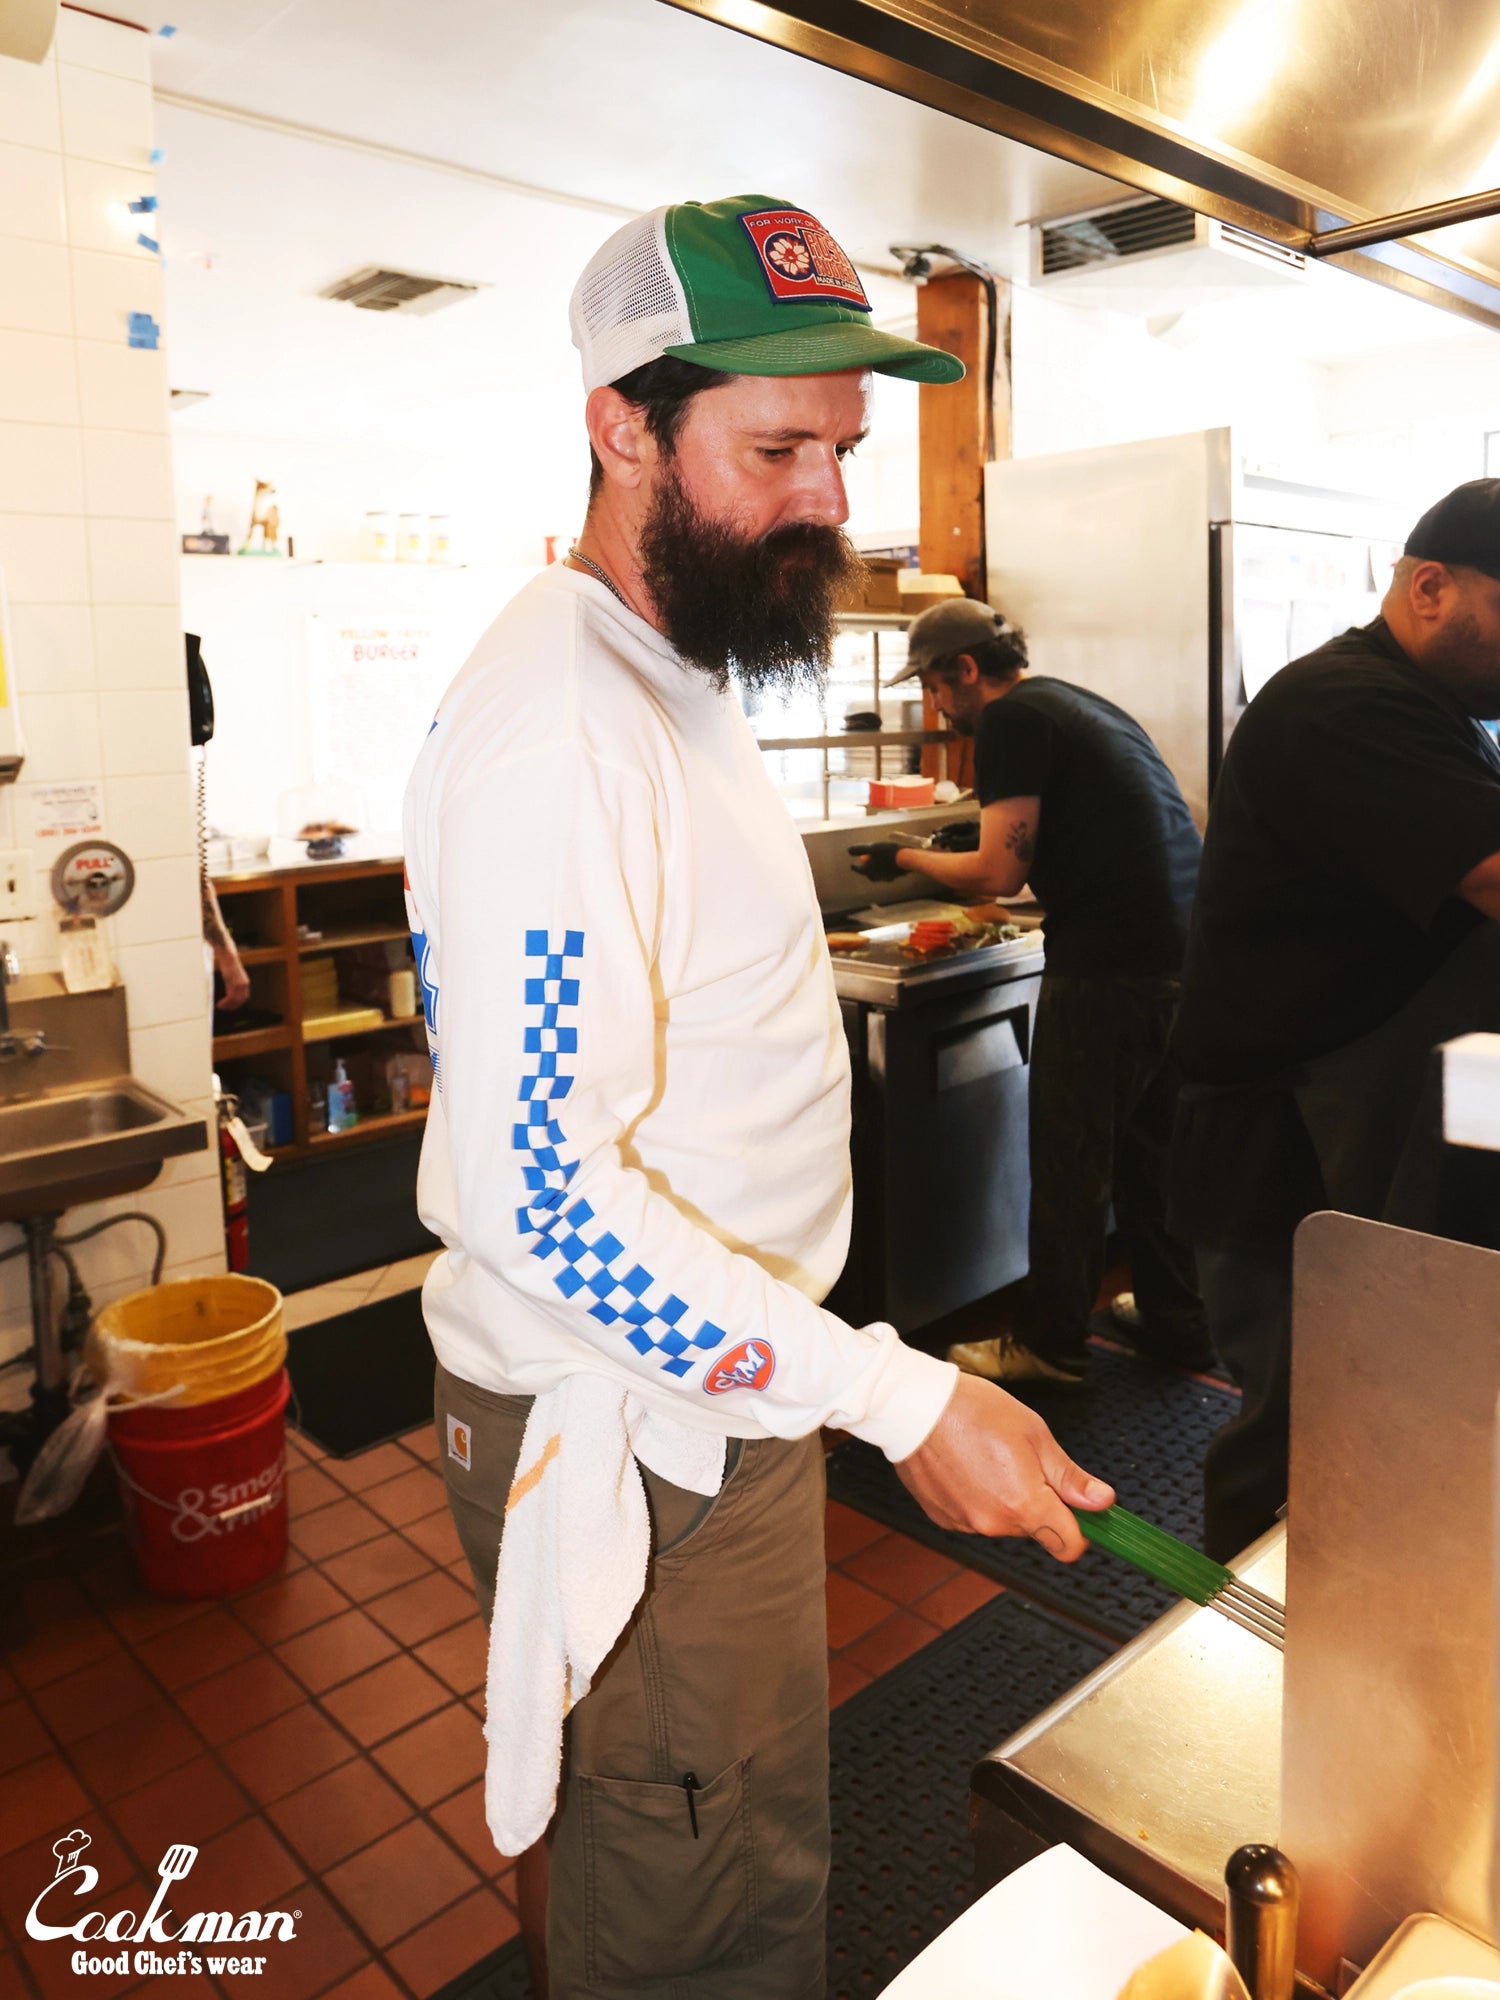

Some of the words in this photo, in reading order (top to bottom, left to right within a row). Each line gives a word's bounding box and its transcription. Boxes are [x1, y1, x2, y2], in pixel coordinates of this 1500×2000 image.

[749, 219, 771, 228] FOR
[774, 217, 803, 225] WORK
[816, 276, 835, 286] MADE
[353, 644, 418, 663] BURGER
[75, 857, 111, 871] PULL
